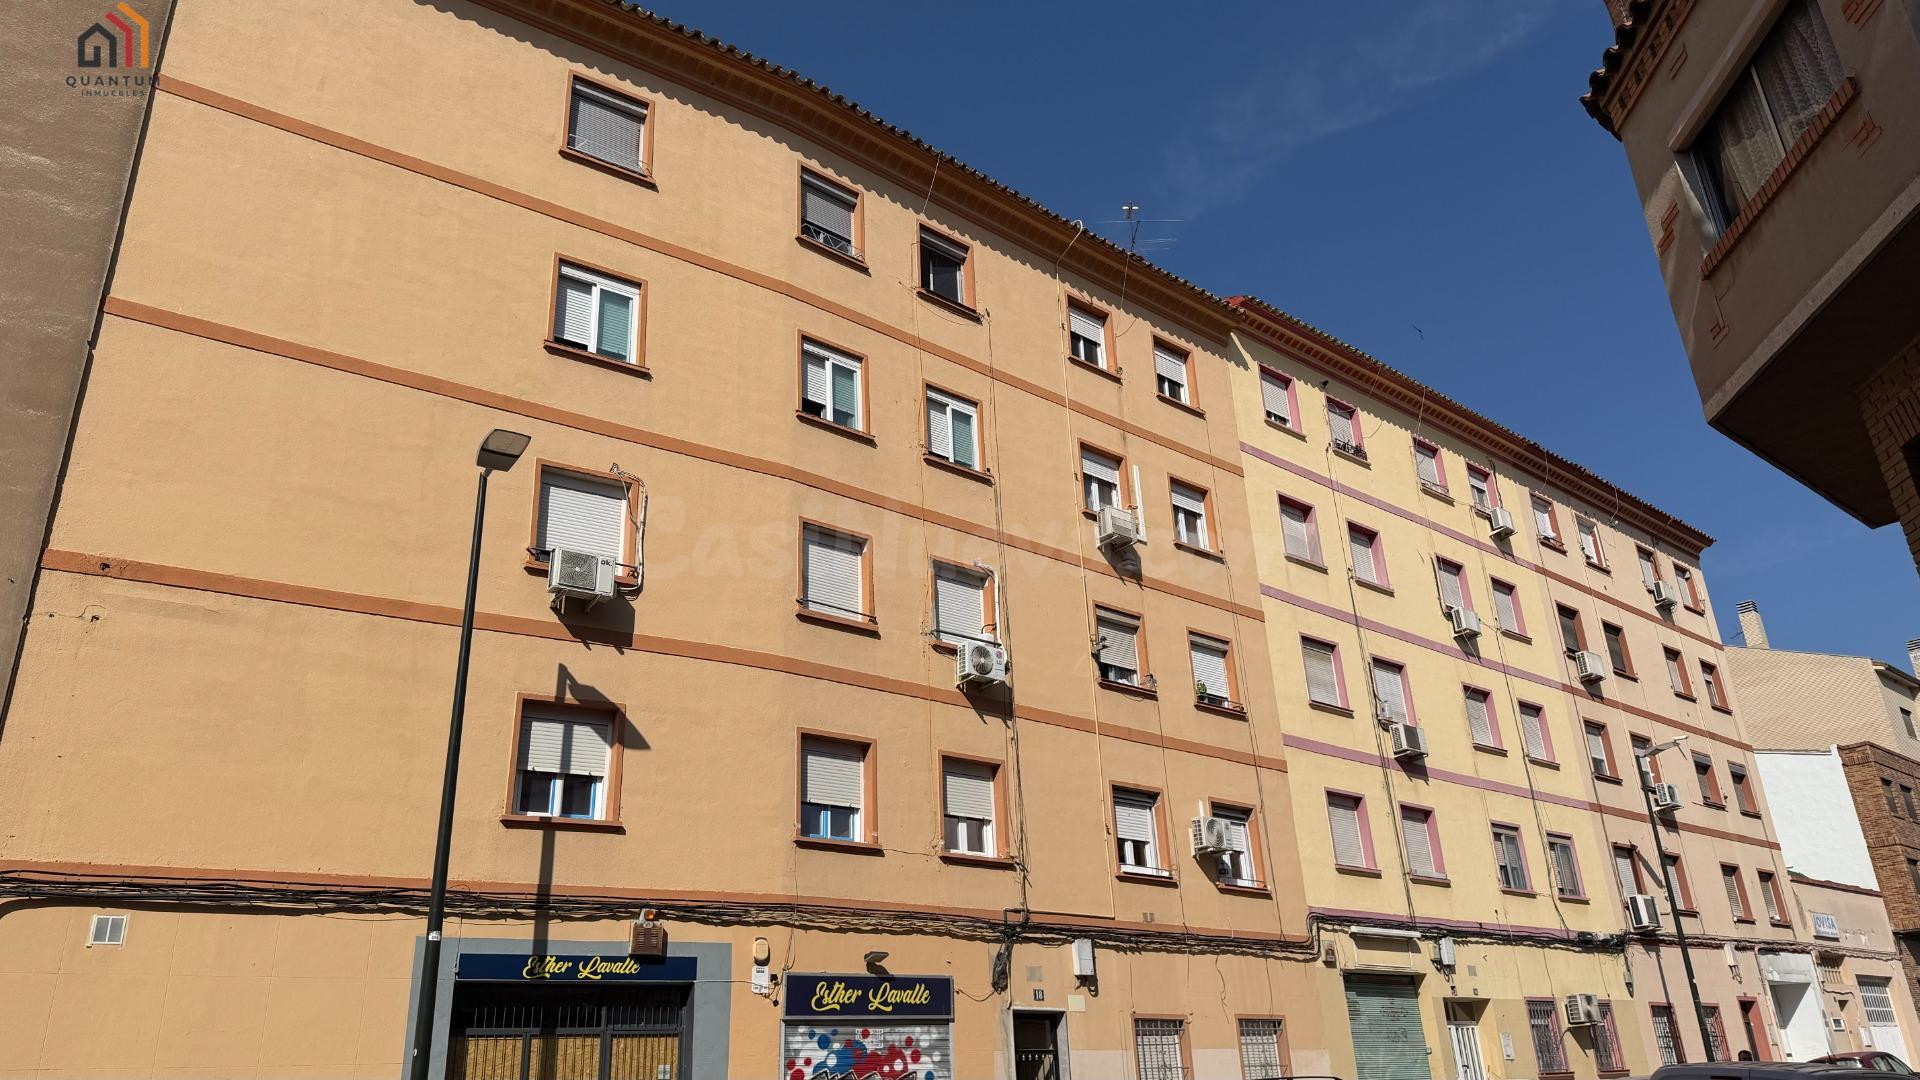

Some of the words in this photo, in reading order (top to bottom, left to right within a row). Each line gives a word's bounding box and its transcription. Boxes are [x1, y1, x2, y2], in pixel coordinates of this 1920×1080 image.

[522, 955, 573, 979] Esther
[577, 956, 641, 980] Lavalle
[811, 981, 863, 1012] Esther
[868, 982, 931, 1012] Lavalle
[1034, 989, 1044, 1000] 18
